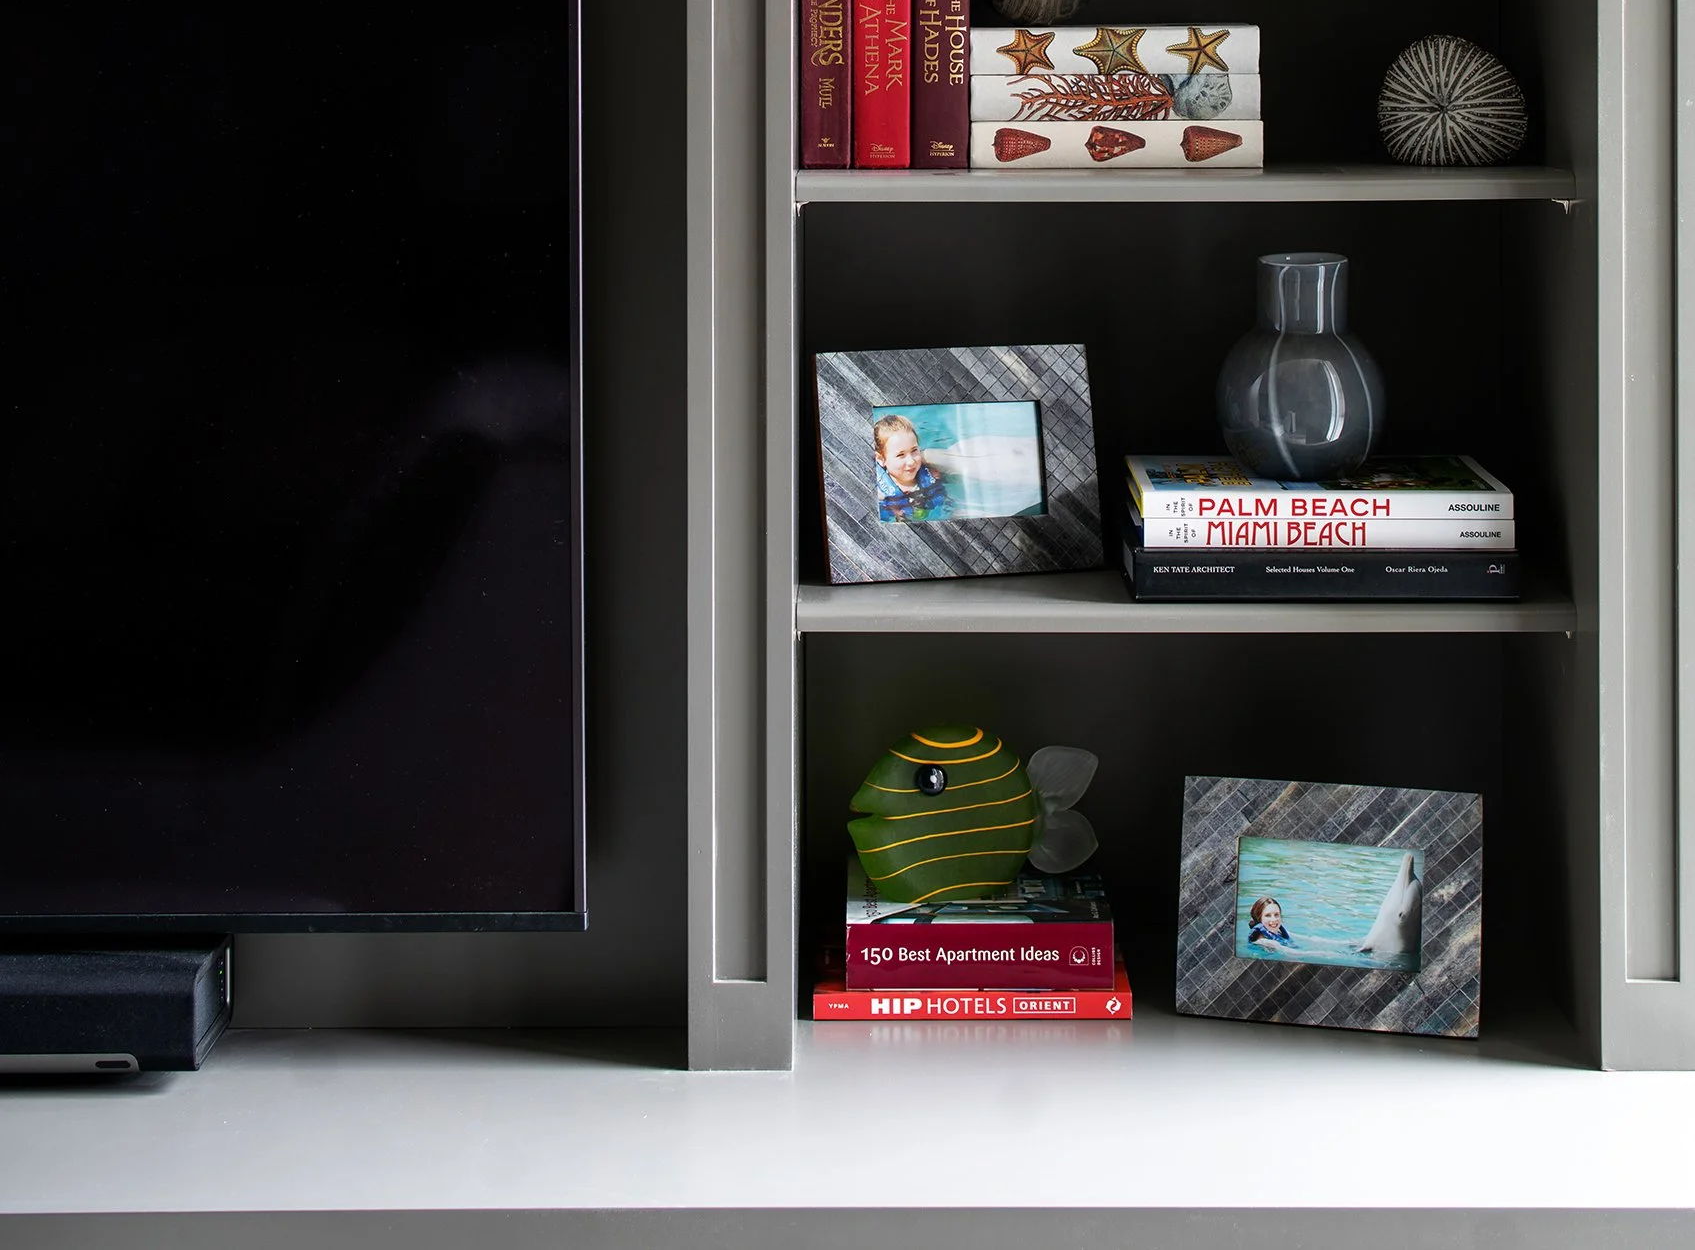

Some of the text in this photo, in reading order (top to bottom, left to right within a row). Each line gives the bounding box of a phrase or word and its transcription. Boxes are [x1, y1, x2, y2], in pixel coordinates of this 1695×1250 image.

[809, 9, 818, 48] PROPHECY
[859, 3, 882, 96] ATHENA
[919, 9, 942, 84] HADES
[944, 14, 967, 86] HOUSE
[884, 18, 908, 91] MARK
[870, 143, 894, 153] Disney
[929, 141, 954, 151] Disney
[1166, 503, 1170, 511] IN
[1188, 503, 1193, 512] OF
[1198, 498, 1391, 517] PALM BEACH
[1448, 503, 1501, 512] ASSOULINE
[1169, 529, 1173, 537] IN
[1191, 529, 1196, 538] OF
[1206, 521, 1367, 546] MIAMI BEACH
[1265, 565, 1355, 573] Selected Houses Volume One
[1385, 565, 1449, 575] Oscar Riera Ojeda
[860, 946, 1060, 965] 150 Best Apartment Ideas
[871, 998, 1007, 1015] HIP HOTELS
[1019, 1000, 1070, 1011] ORIENT
